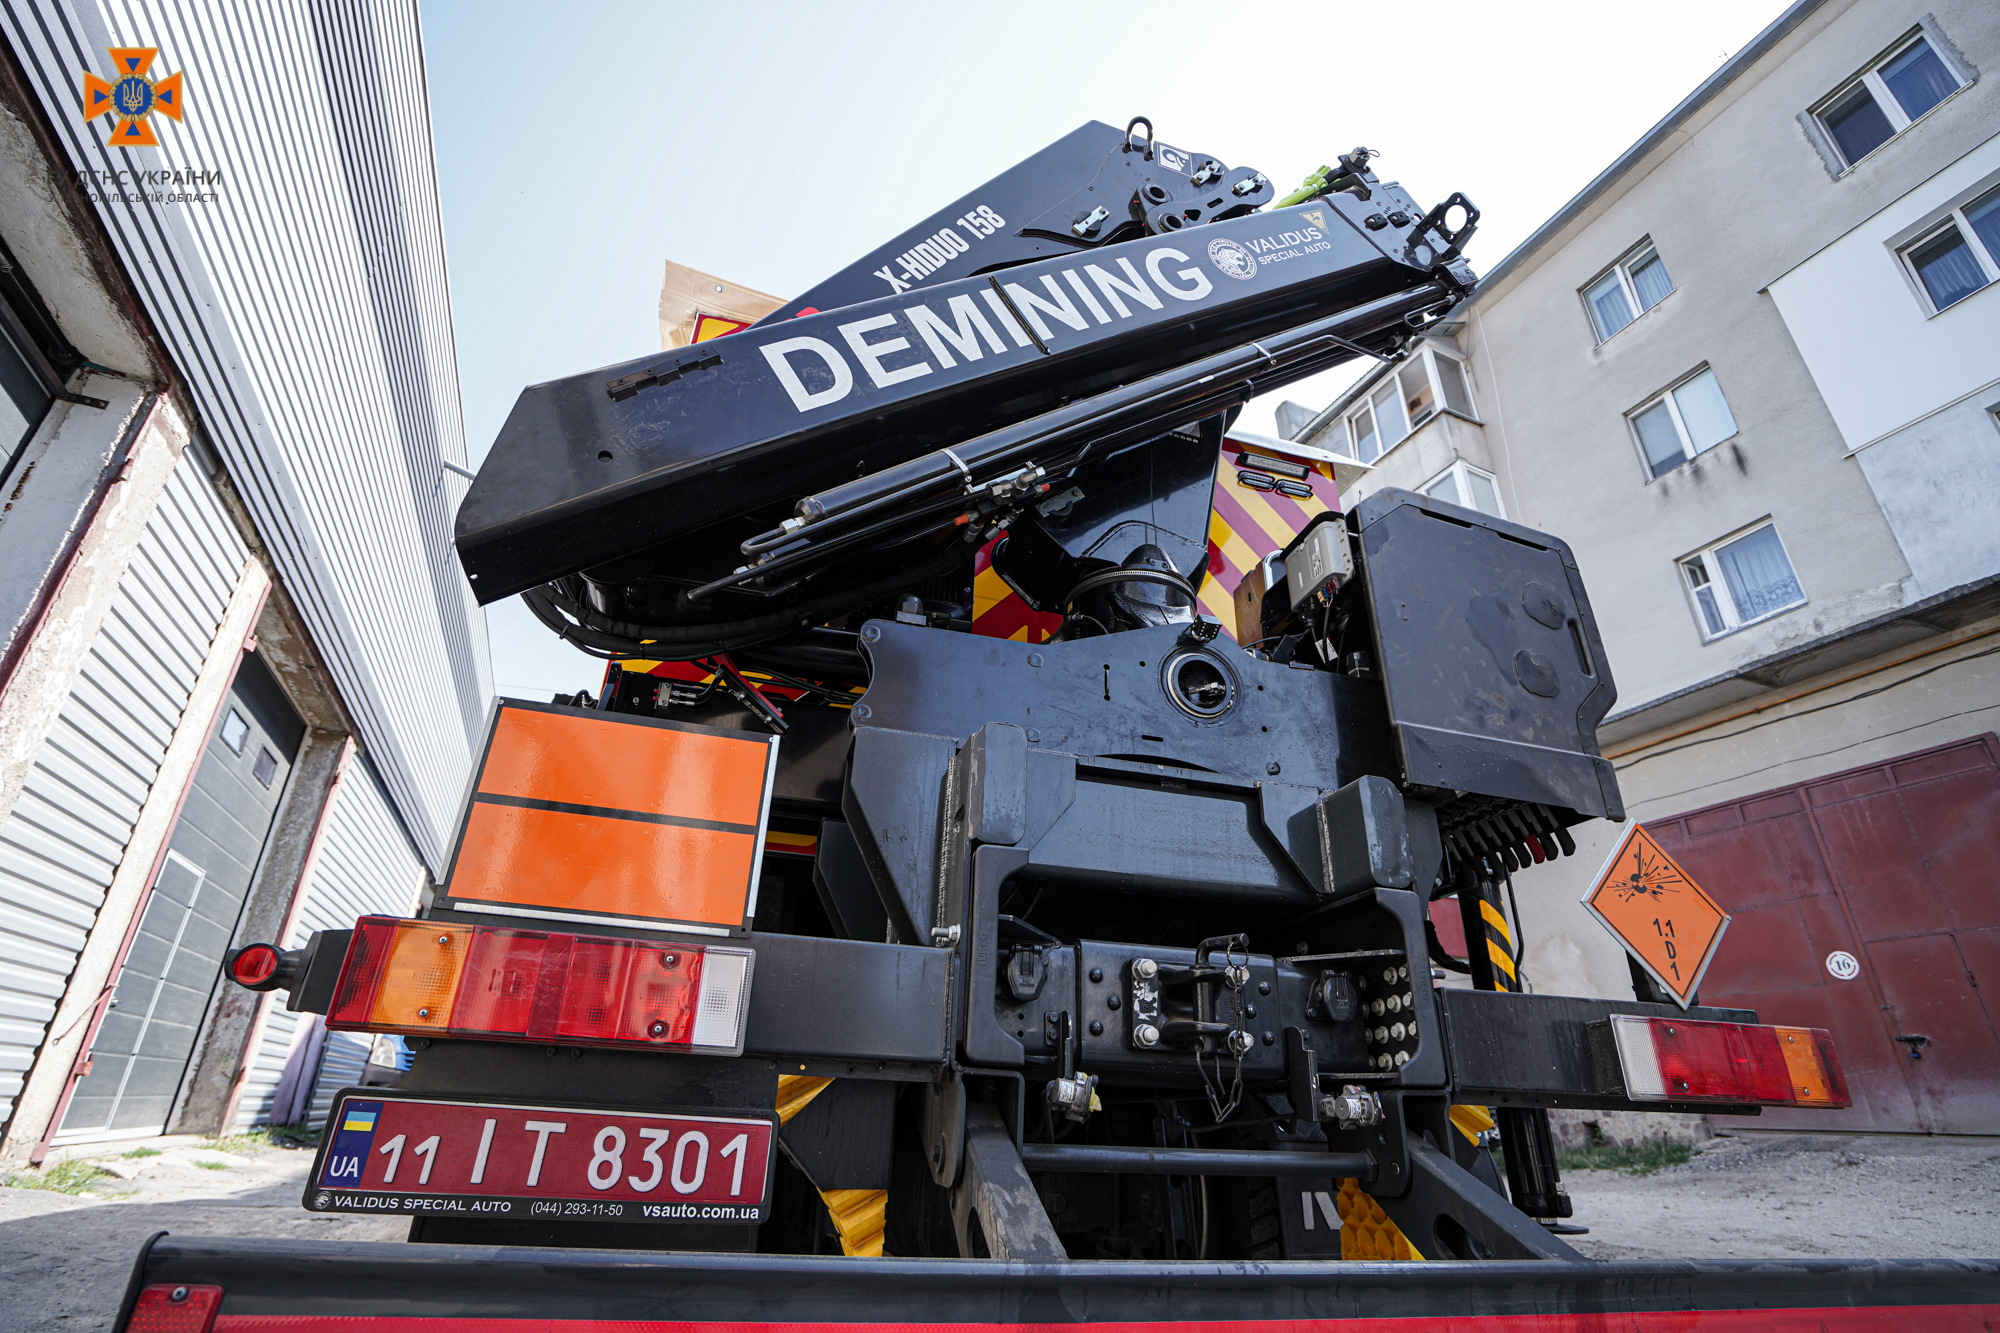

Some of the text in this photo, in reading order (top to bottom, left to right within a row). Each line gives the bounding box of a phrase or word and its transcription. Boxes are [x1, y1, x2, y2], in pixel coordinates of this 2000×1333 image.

[872, 204, 1006, 294] X-HIDUO 158
[1245, 227, 1322, 253] VALIDUS
[1258, 241, 1331, 265] SPECIAL AUTO
[758, 247, 1213, 413] DEMINING
[1653, 918, 1675, 938] 1.1
[1664, 940, 1677, 959] D
[1670, 961, 1680, 981] 1
[1836, 958, 1851, 971] 16
[329, 1155, 359, 1178] UA
[379, 1134, 441, 1185] 11
[587, 1125, 749, 1197] 8301
[334, 1195, 759, 1220] VALIDUS SPECIAL AUTO (044) 293-11-50 vsauto.com.ua
